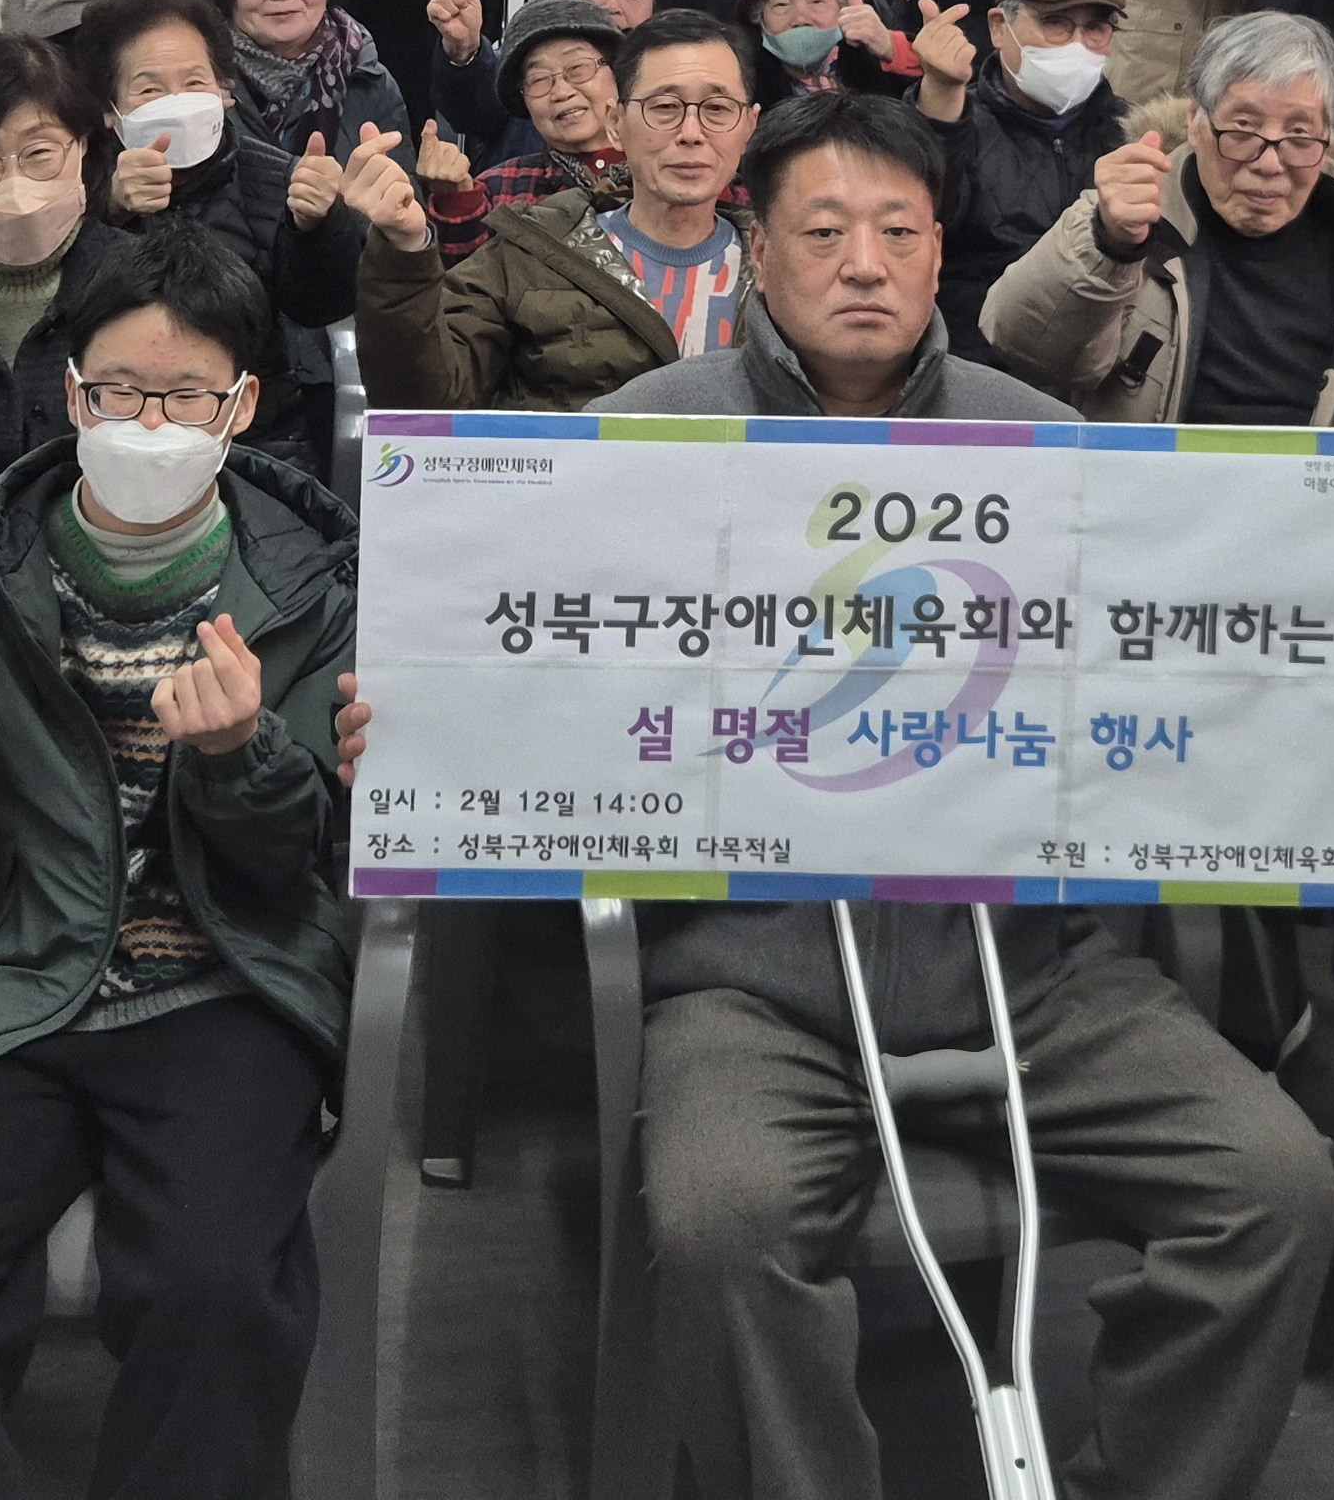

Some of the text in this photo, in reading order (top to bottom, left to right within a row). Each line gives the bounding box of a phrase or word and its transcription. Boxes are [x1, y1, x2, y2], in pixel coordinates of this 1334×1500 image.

[423, 456, 553, 475] 성북구장애인체육회
[827, 491, 1010, 544] 2026
[485, 591, 1334, 665] 성북구장애인체육회와 함께하는
[627, 706, 1194, 772] 설 명절 사랑나눔 행사
[369, 788, 416, 815] 일시
[460, 789, 501, 816] 2월
[519, 790, 576, 817] 12일
[593, 792, 684, 815] 14:00
[367, 833, 416, 860] 장소
[457, 833, 679, 863] 성북구장애인체육회
[696, 835, 791, 864] 다목적실
[1036, 839, 1087, 869] 후원
